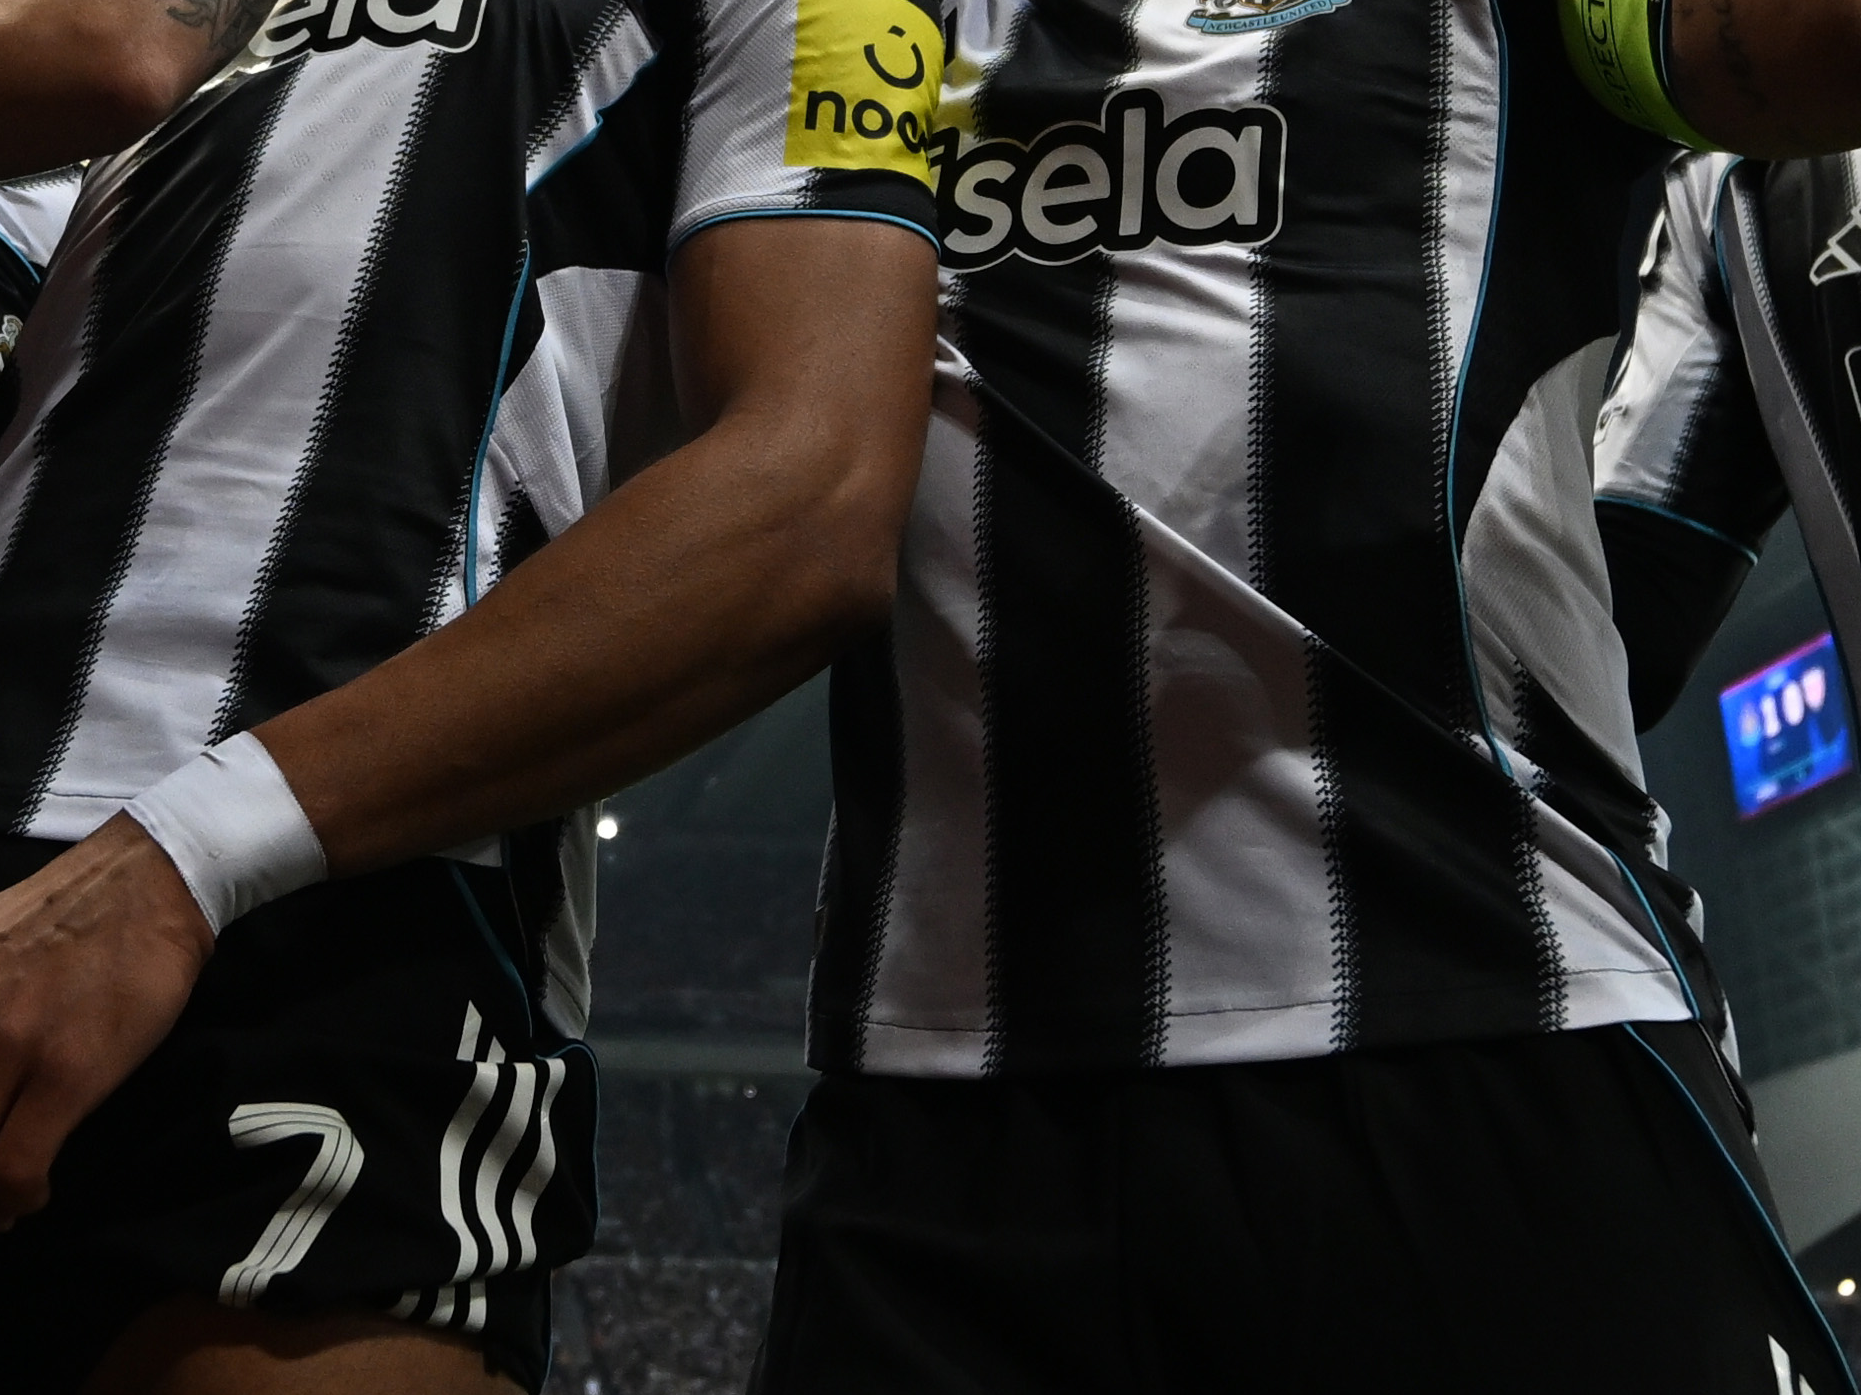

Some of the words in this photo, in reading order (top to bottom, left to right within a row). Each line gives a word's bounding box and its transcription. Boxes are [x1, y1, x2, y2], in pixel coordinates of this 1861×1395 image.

[1207, 15, 1280, 32] NEWCASTLE
[1279, 0, 1328, 21] UNITED
[804, 90, 928, 154] noo
[943, 106, 1263, 255] sela
[217, 1101, 365, 1305] 7
